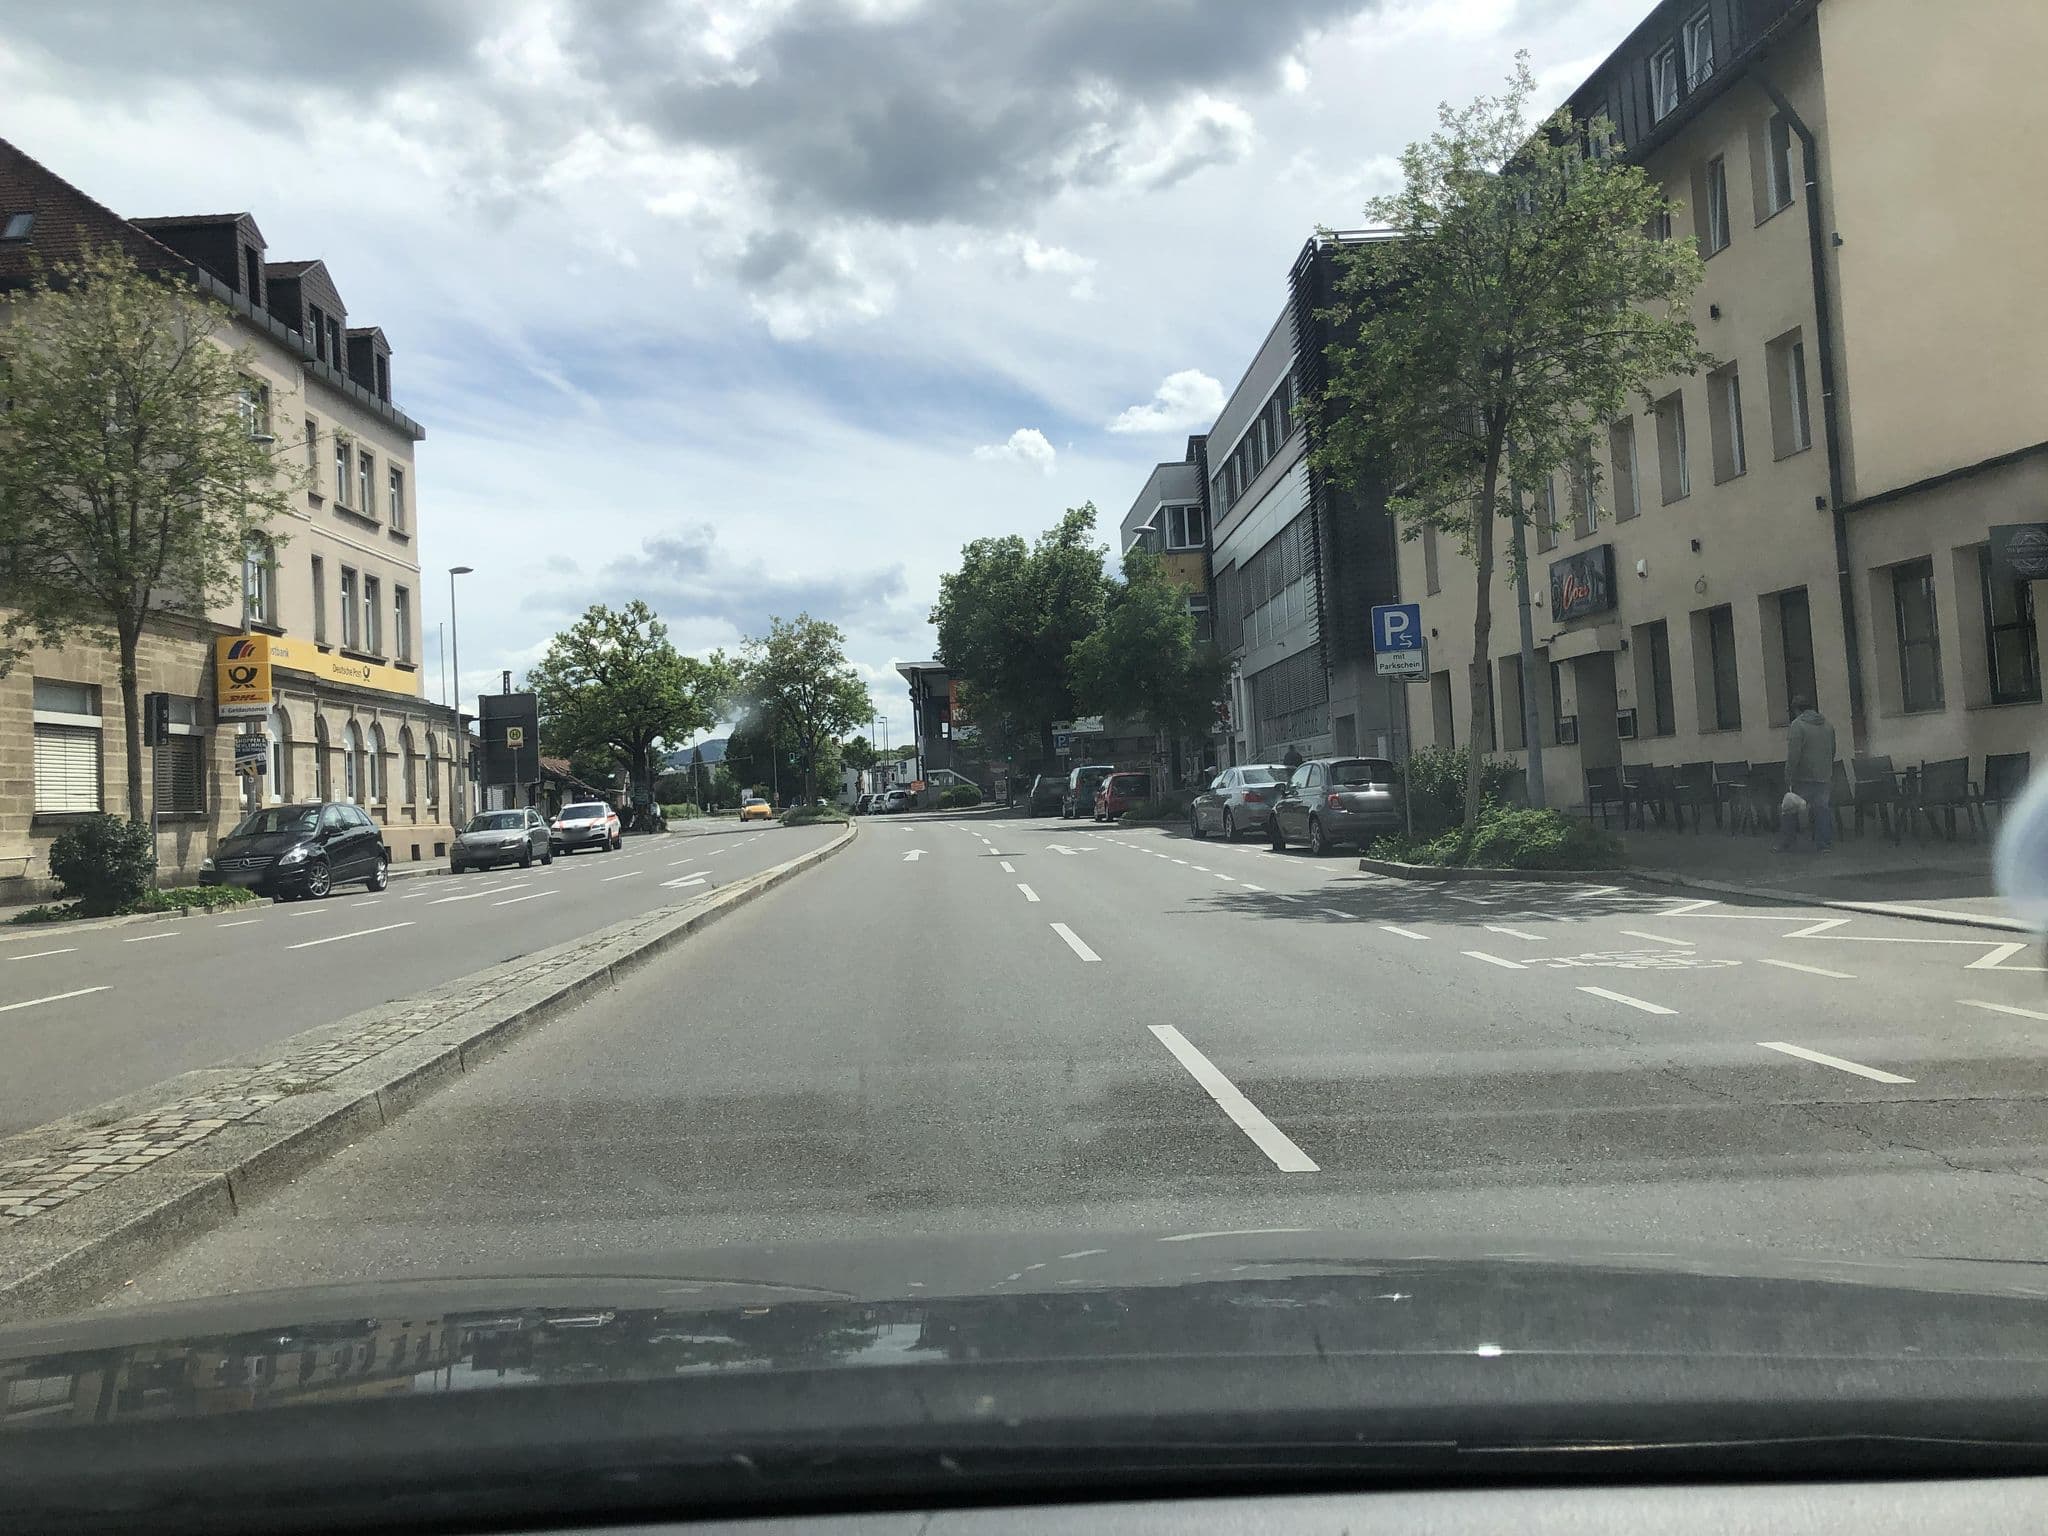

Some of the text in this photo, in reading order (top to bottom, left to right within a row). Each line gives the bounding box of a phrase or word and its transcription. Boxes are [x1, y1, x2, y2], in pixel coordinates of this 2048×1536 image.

[1384, 611, 1409, 646] P
[271, 647, 288, 657] stbank
[1380, 662, 1420, 670] Parkschein
